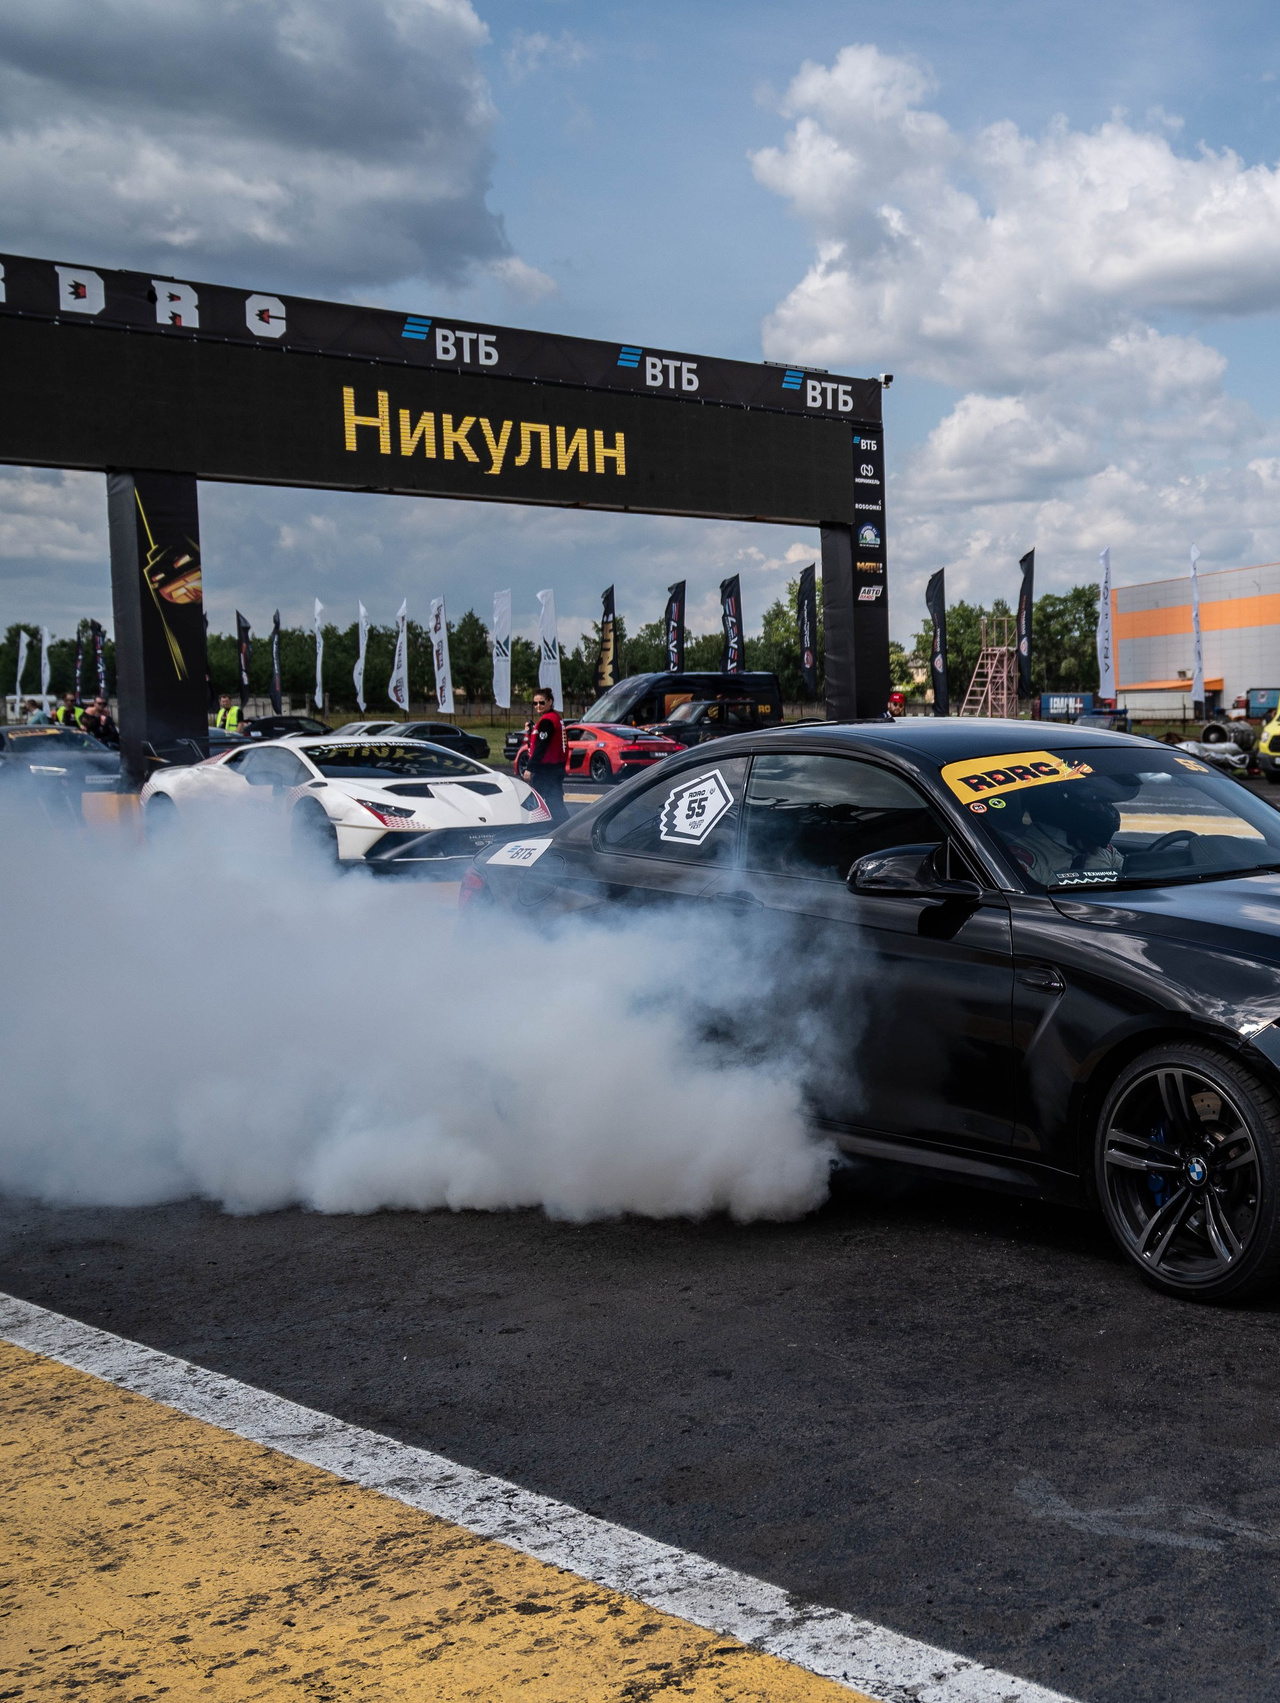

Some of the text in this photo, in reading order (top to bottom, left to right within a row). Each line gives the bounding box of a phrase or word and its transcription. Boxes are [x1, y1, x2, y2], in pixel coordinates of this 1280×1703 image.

[435, 328, 499, 366] ВТБ
[645, 356, 699, 392] ВТБ
[806, 379, 853, 413] ВТБ
[343, 385, 626, 475] Никулин
[861, 439, 877, 450] ВТБ
[1173, 757, 1209, 773] 55
[685, 796, 708, 820] 55
[510, 847, 538, 860] ВТБ
